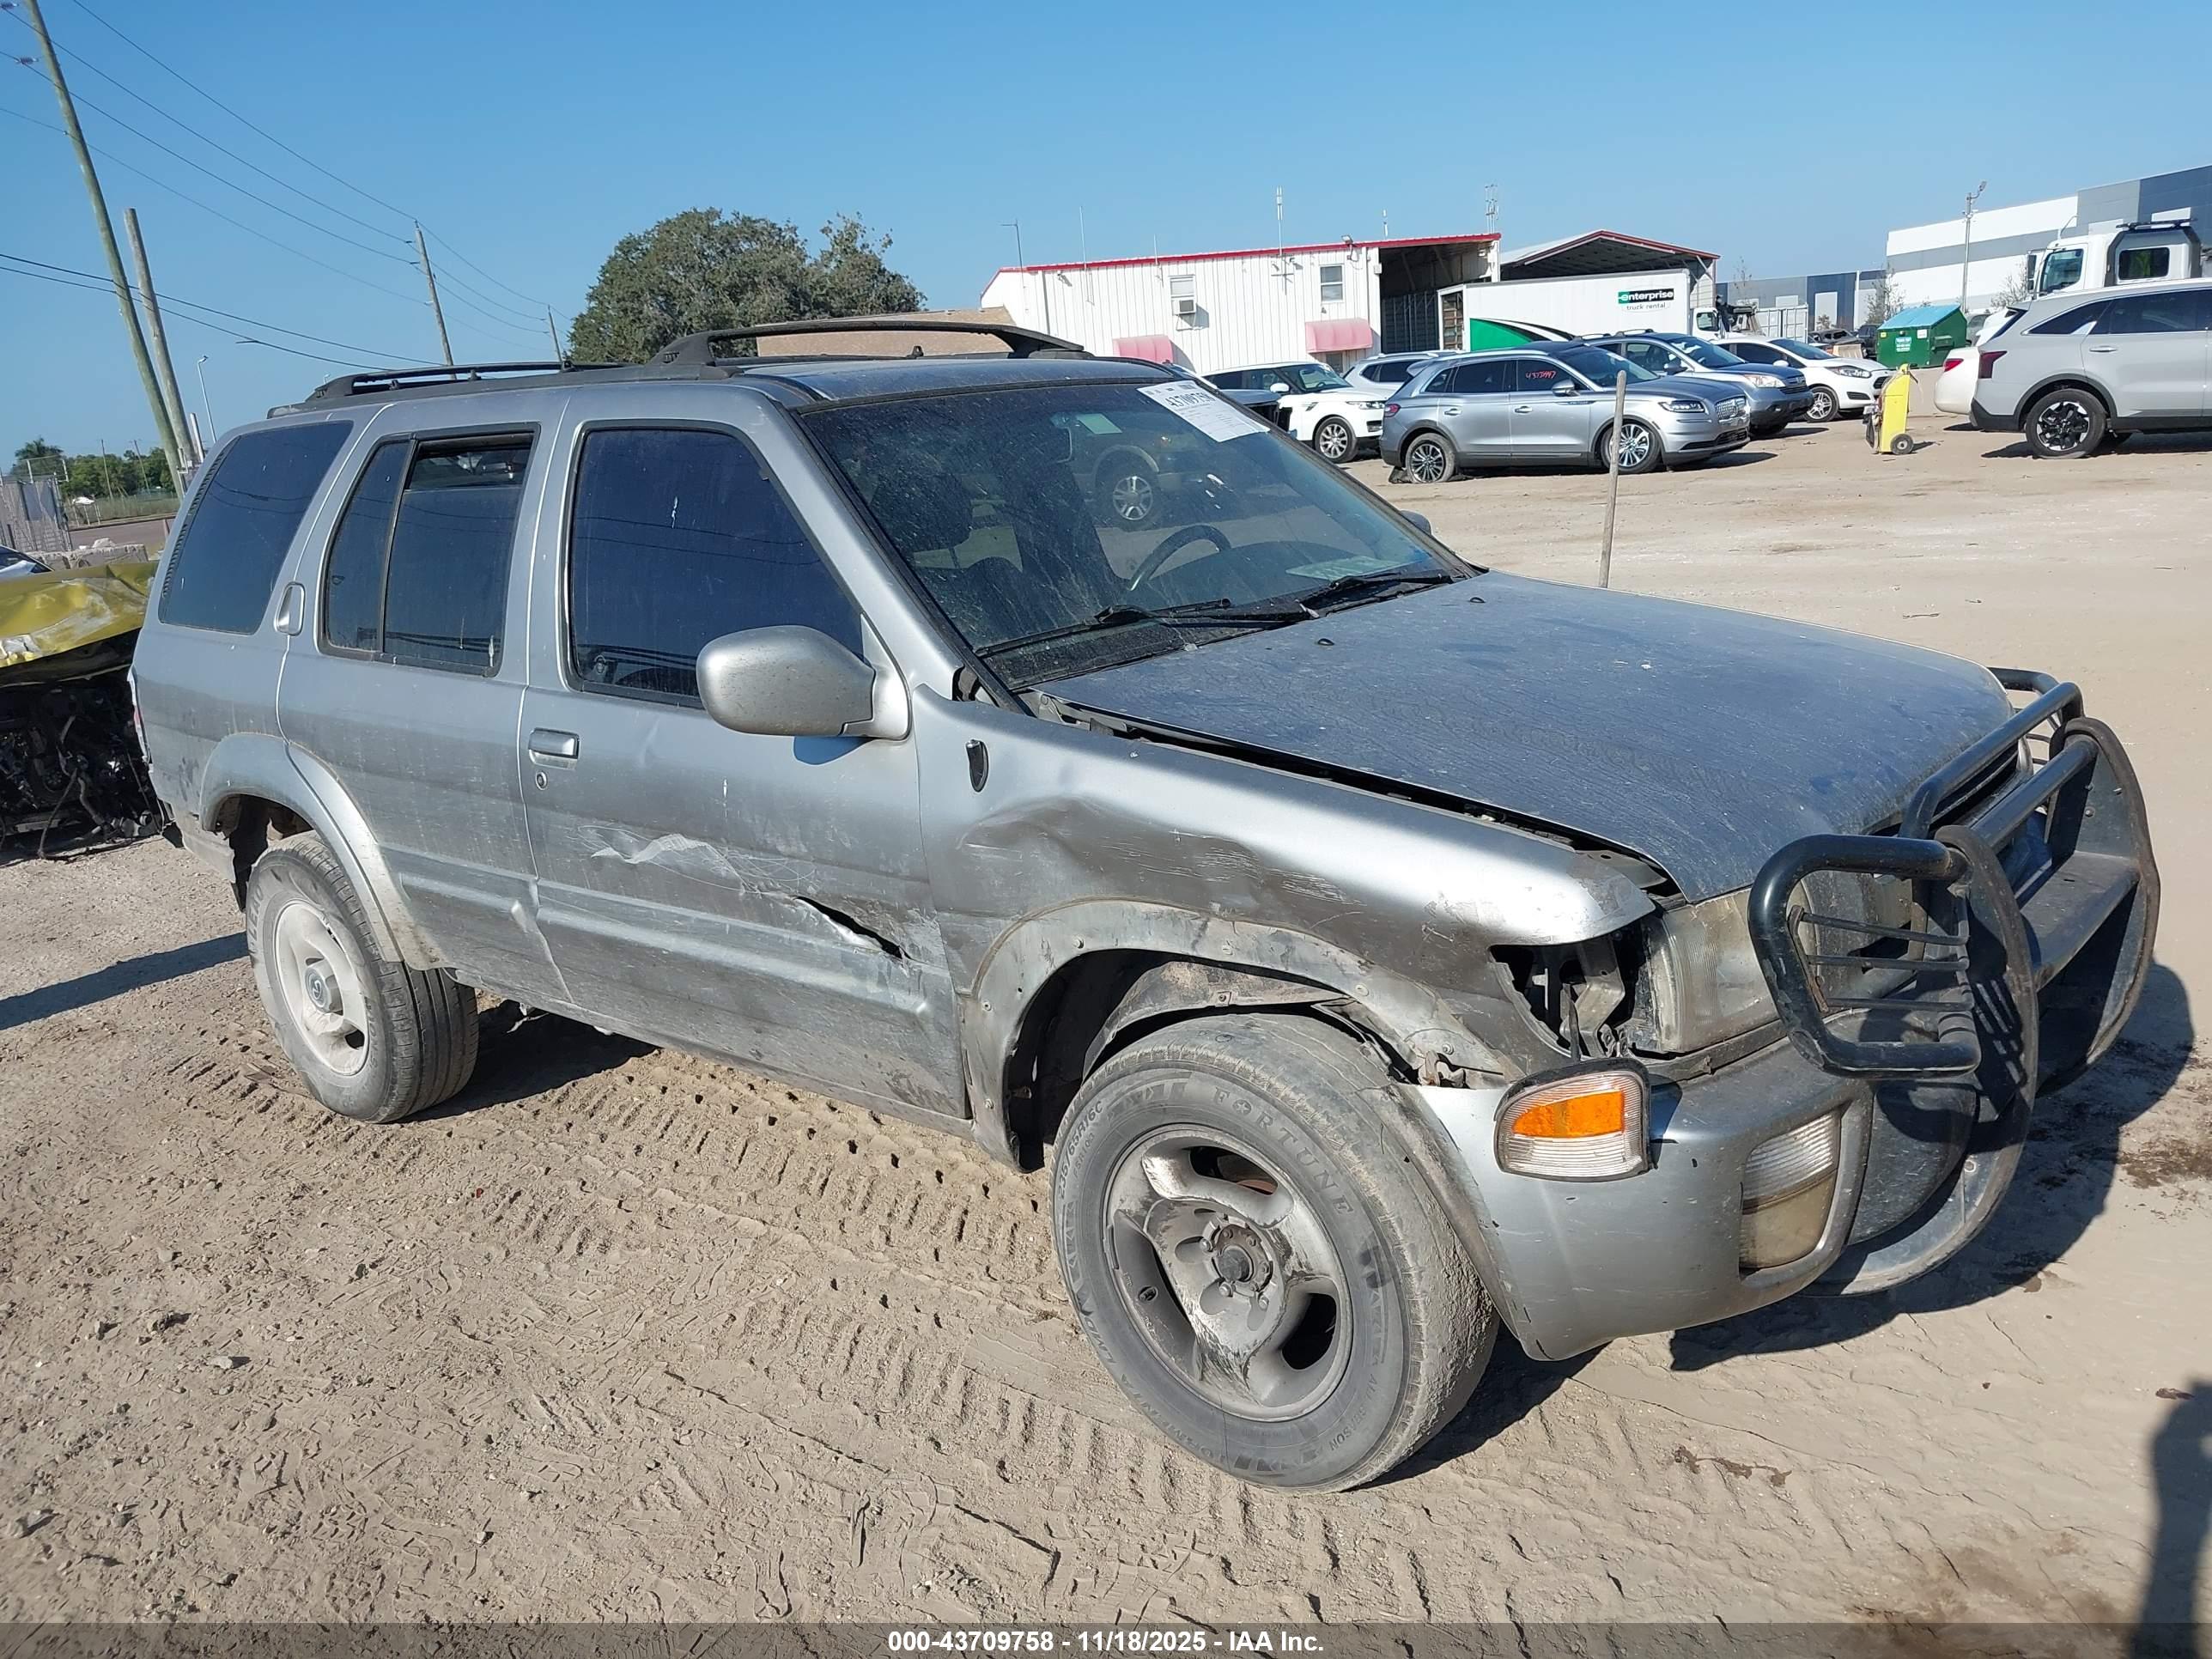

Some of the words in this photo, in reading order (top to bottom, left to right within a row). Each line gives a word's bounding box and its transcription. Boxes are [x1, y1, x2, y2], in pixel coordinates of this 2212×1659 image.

[1620, 290, 1674, 301] enterprise
[1645, 301, 1666, 310] rental
[1058, 1100, 1103, 1200] 235/65R16C
[1212, 1086, 1354, 1214] FORTUNE
